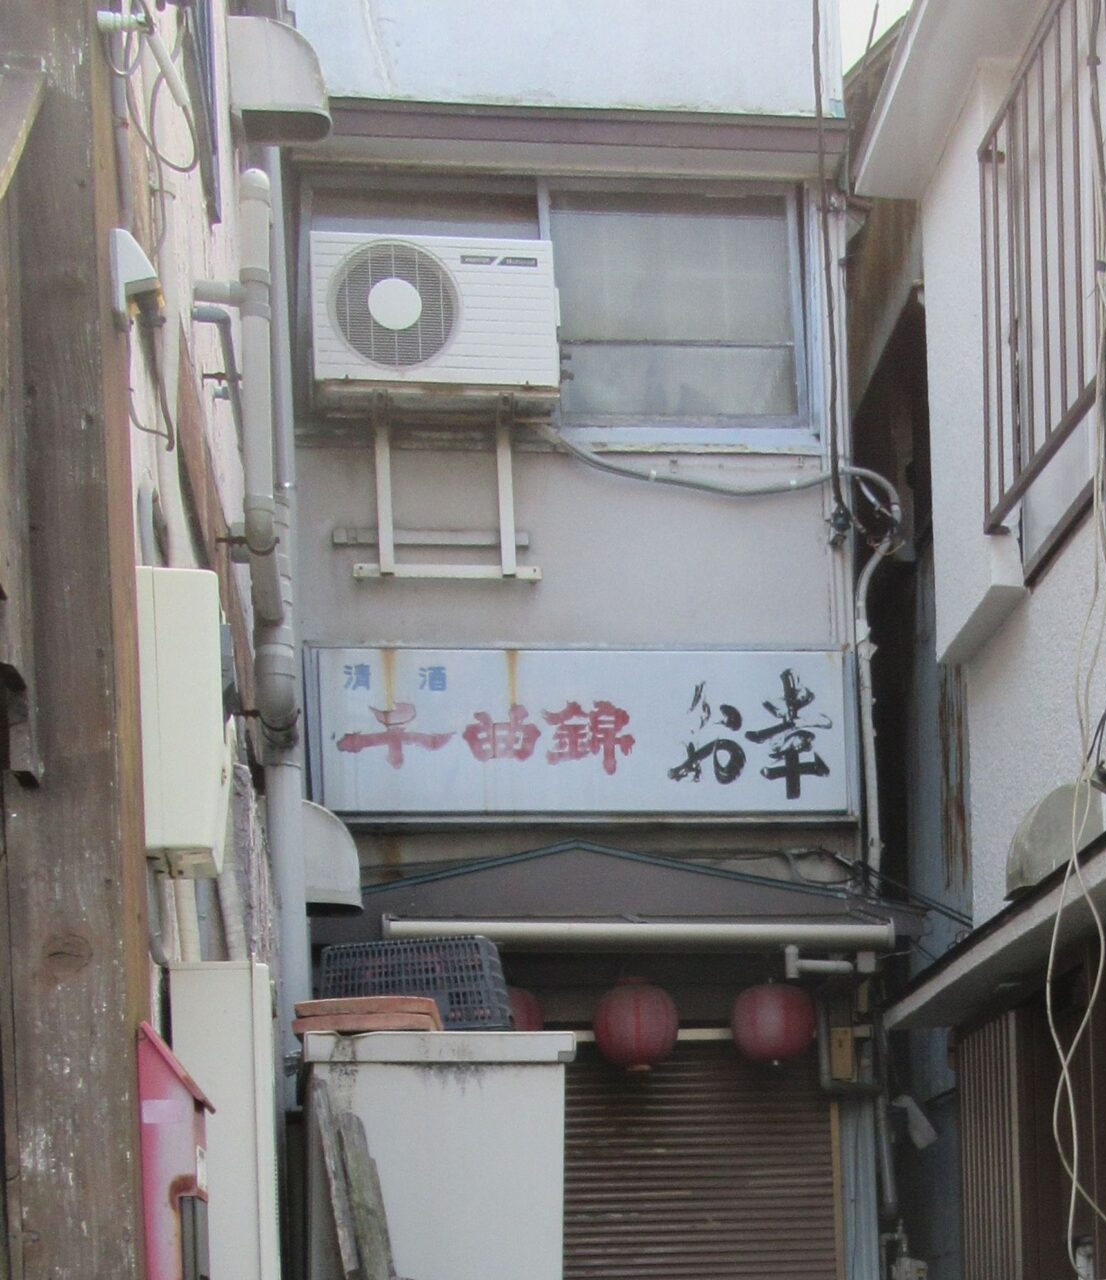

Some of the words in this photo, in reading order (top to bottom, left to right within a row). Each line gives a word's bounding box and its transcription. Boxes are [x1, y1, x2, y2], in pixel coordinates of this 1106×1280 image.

[343, 663, 448, 692] 清酒
[337, 700, 636, 775] 千曲錦
[667, 668, 833, 800] お幸
